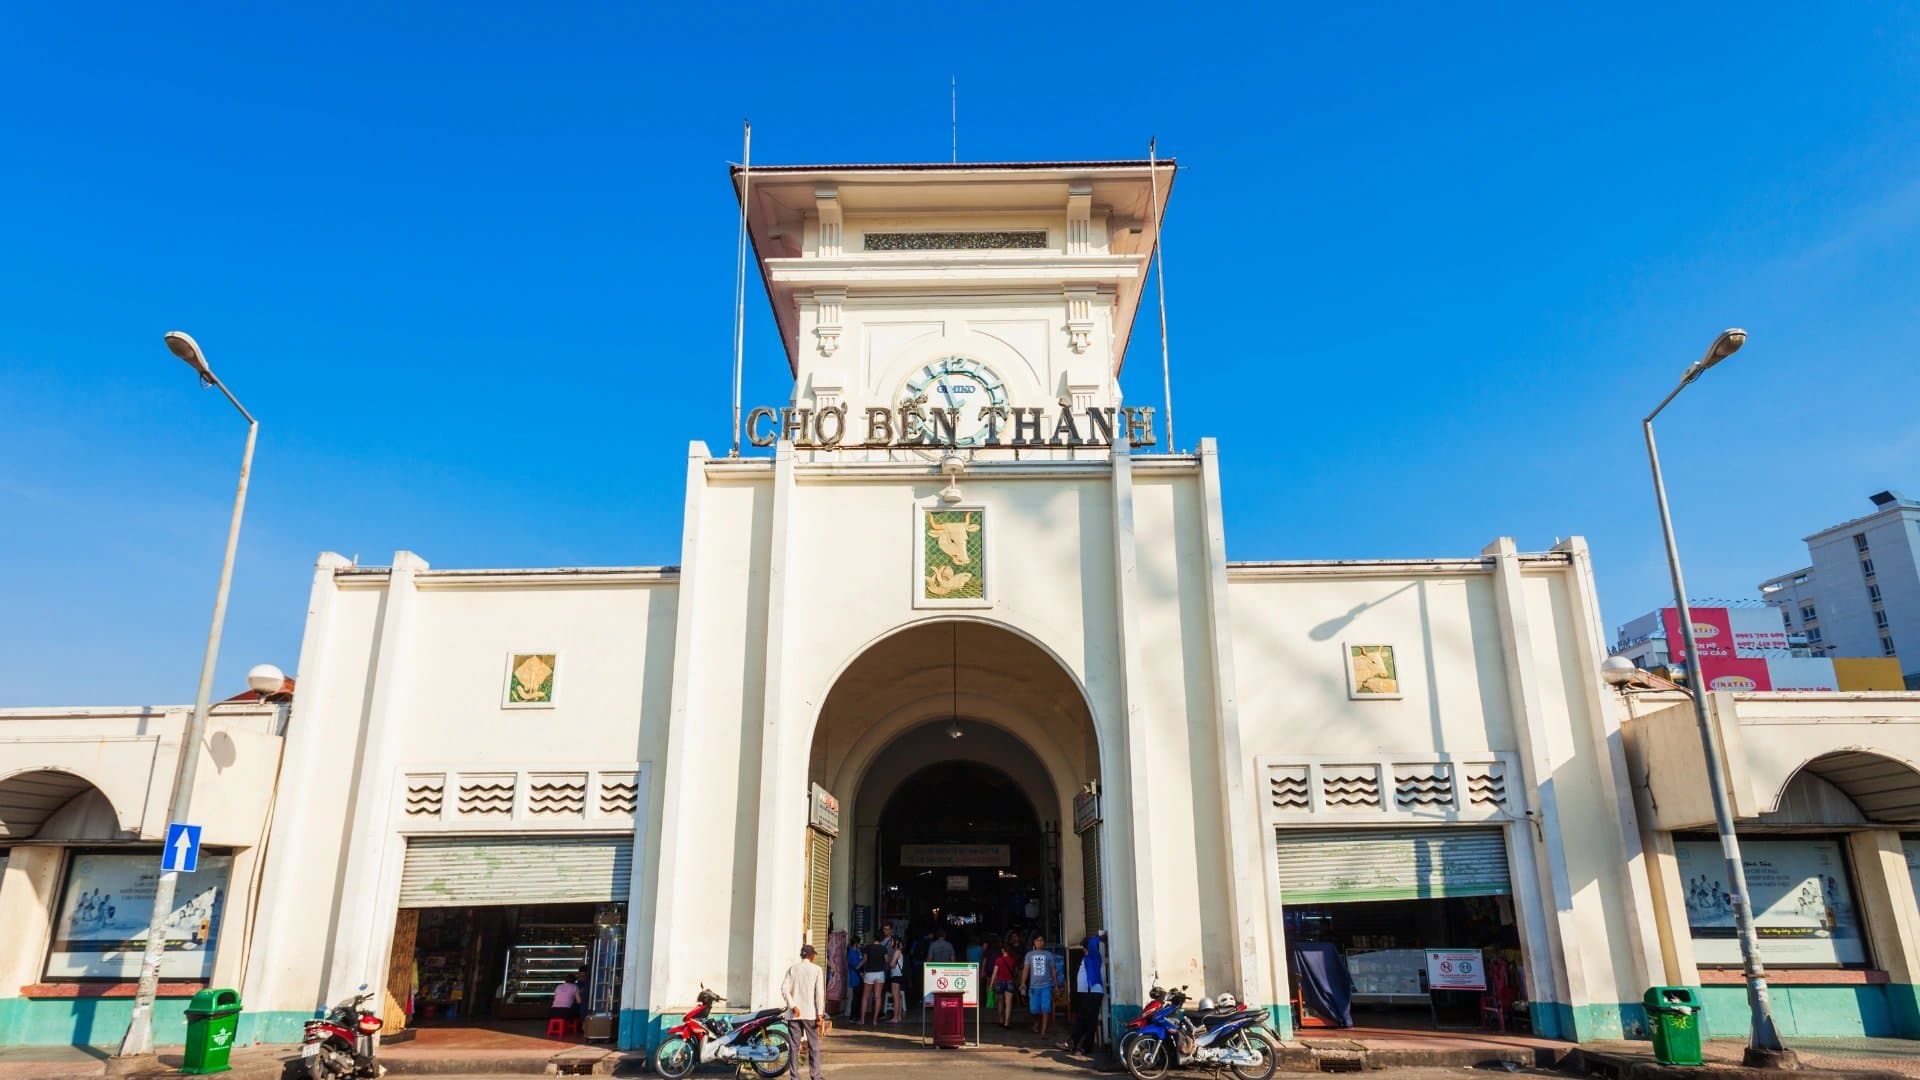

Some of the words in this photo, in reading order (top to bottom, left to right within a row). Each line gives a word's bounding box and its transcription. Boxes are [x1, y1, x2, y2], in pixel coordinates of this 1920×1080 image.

[746, 402, 848, 452] CHỢ
[863, 394, 959, 447] BẾN
[978, 397, 1156, 446] THÀNH
